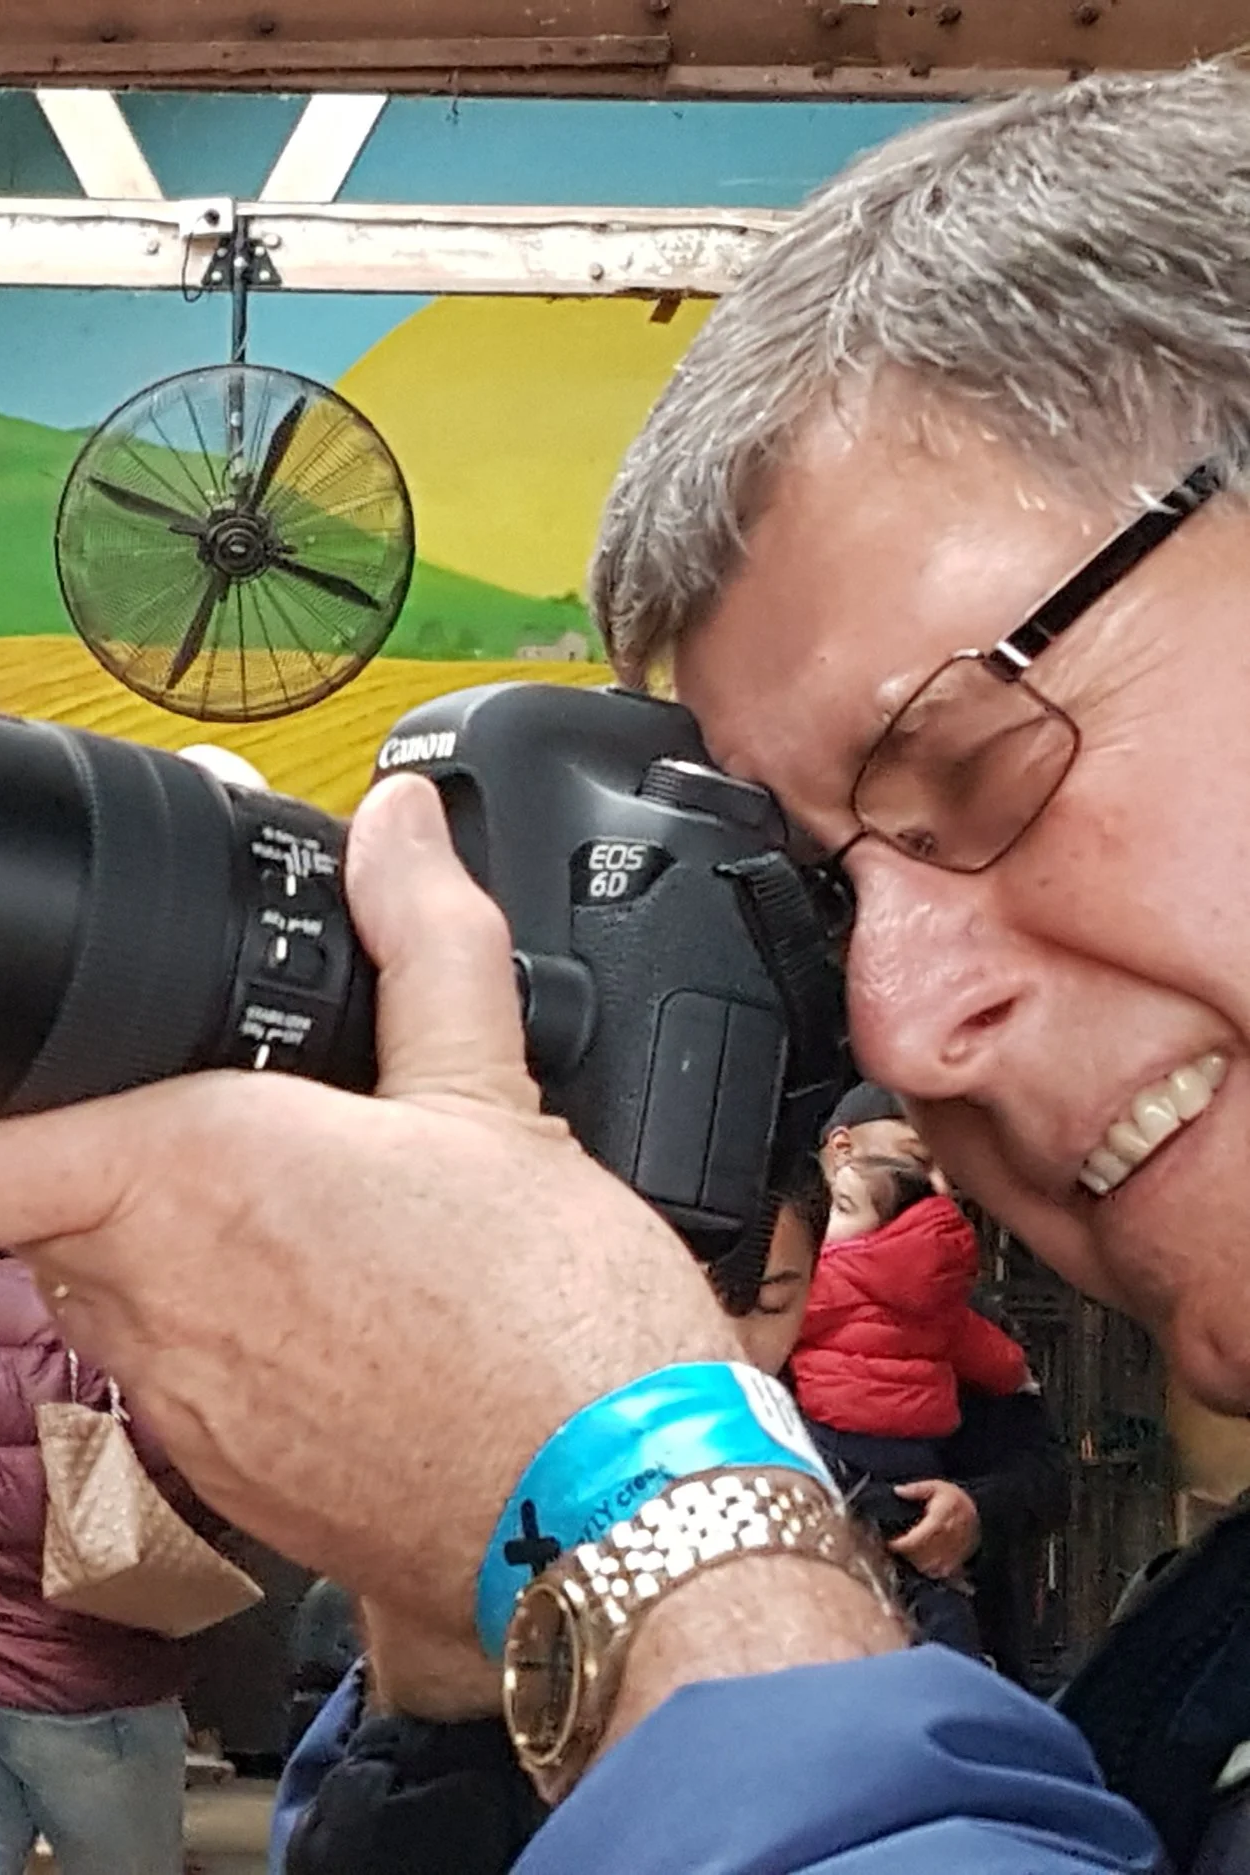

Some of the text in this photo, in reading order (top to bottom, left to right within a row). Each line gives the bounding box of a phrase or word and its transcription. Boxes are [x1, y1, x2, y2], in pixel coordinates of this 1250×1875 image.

[378, 731, 456, 769] Canon
[588, 844, 648, 871] EOS
[589, 870, 629, 898] 6D
